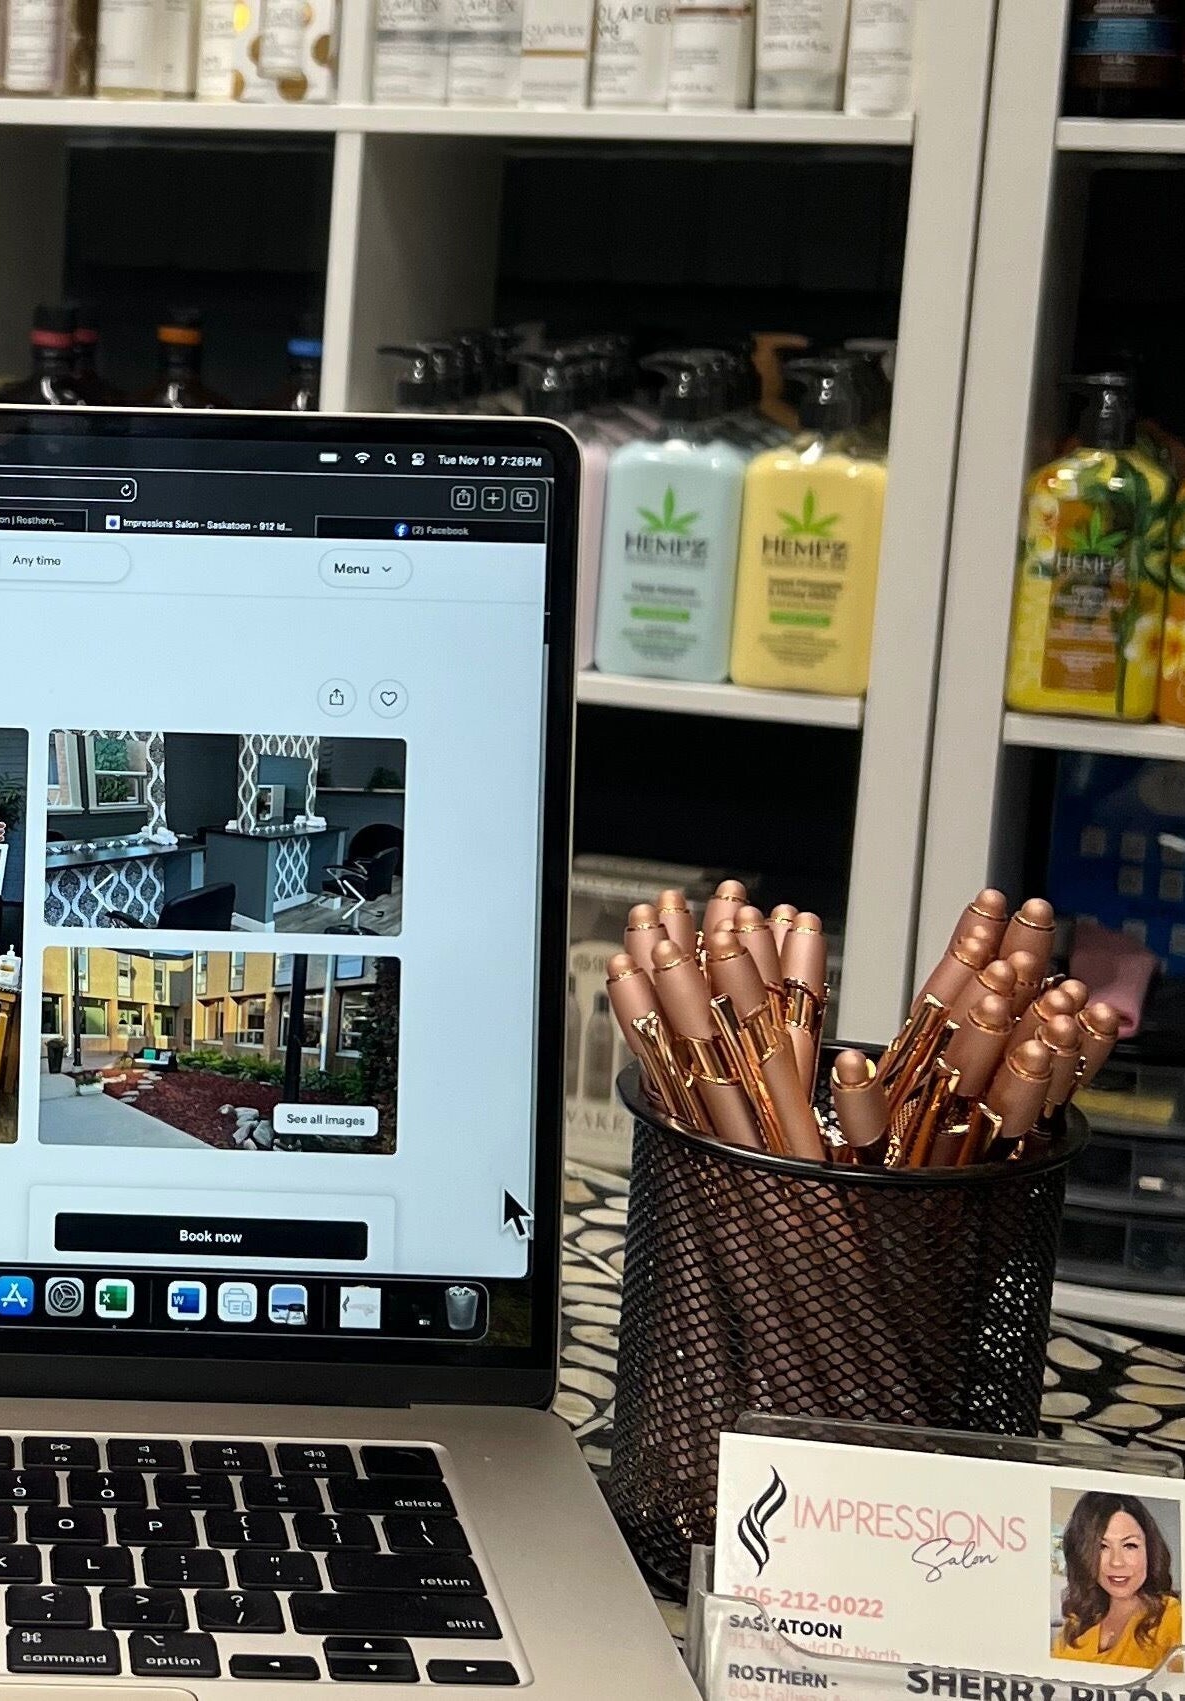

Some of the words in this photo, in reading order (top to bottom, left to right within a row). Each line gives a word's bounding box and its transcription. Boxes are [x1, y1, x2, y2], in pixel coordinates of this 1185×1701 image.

[437, 454, 456, 465] Tue
[459, 455, 480, 466] Nov
[482, 457, 494, 467] 19
[123, 516, 174, 529] Impressions
[176, 518, 199, 529] Salon
[207, 519, 250, 531] Saskatoon
[259, 521, 276, 531] 912
[427, 525, 469, 537] Facebook
[12, 554, 34, 567] Any
[37, 556, 61, 566] time
[333, 563, 370, 575] Menu
[286, 1113, 308, 1125] See
[310, 1114, 323, 1126] all
[325, 1115, 365, 1129] images
[179, 1229, 213, 1242] Book
[216, 1232, 243, 1244] now
[13, 1487, 26, 1497] 9
[101, 1489, 115, 1499] 0
[395, 1499, 442, 1508] delete
[58, 1518, 75, 1530] O
[148, 1520, 163, 1532] P
[794, 1495, 1028, 1553] IMPRESSIONS
[87, 1557, 100, 1570] L
[911, 1536, 999, 1583] Salon
[420, 1576, 471, 1587] return
[445, 1618, 486, 1629] shift
[21, 1653, 107, 1665] command
[145, 1655, 201, 1667] option
[727, 1663, 828, 1690] ROSTHERN
